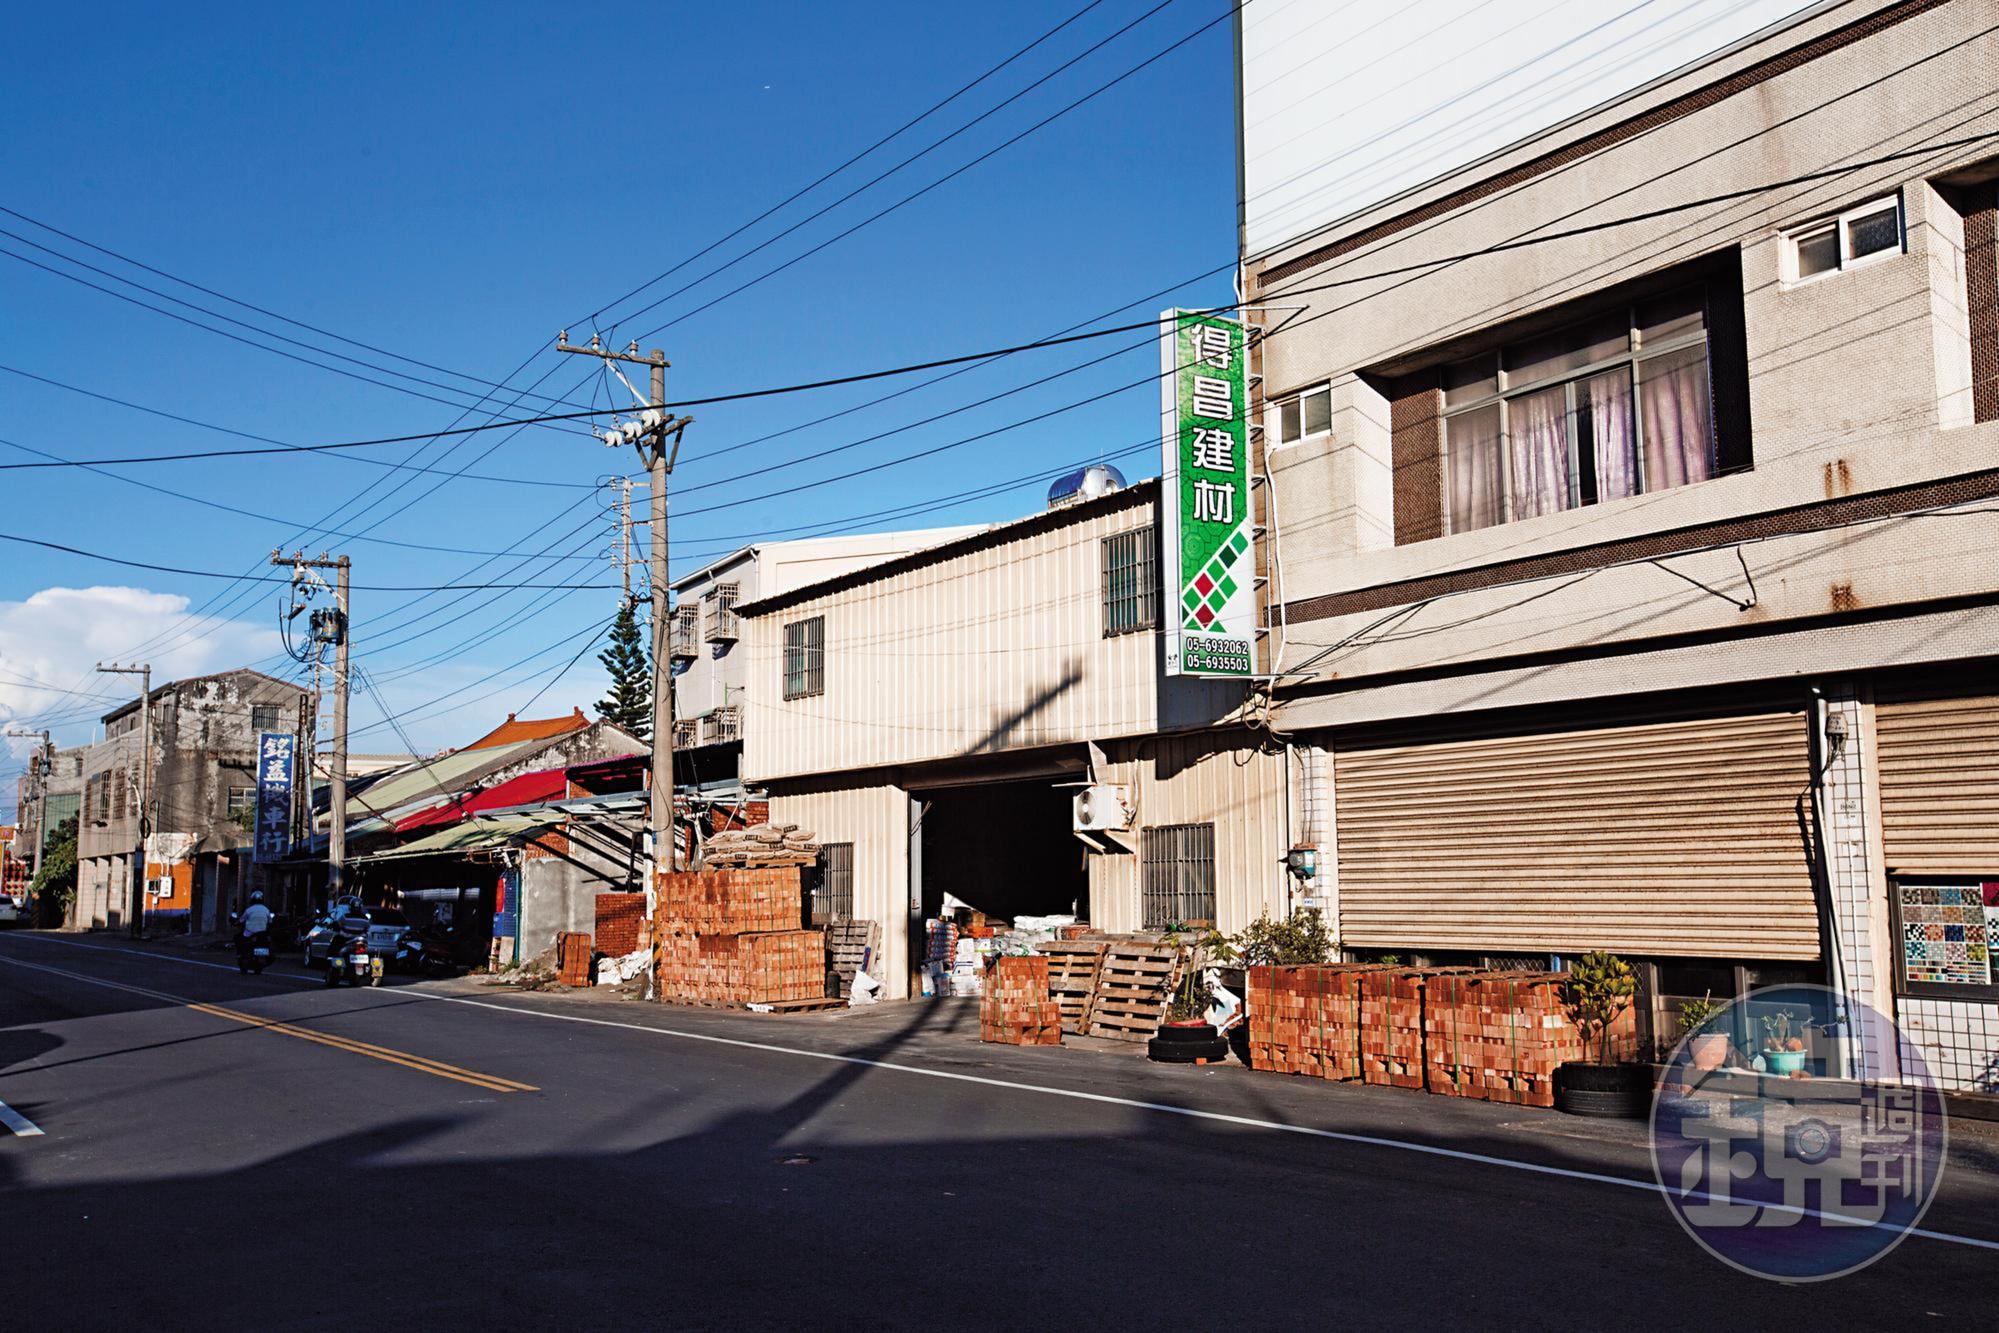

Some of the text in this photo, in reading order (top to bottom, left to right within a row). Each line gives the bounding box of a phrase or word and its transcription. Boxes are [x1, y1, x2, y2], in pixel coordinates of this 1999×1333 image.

[1191, 323, 1235, 525] 得昌建材
[1186, 636, 1249, 656] 05-6932062
[1187, 653, 1249, 671] 05-6935503
